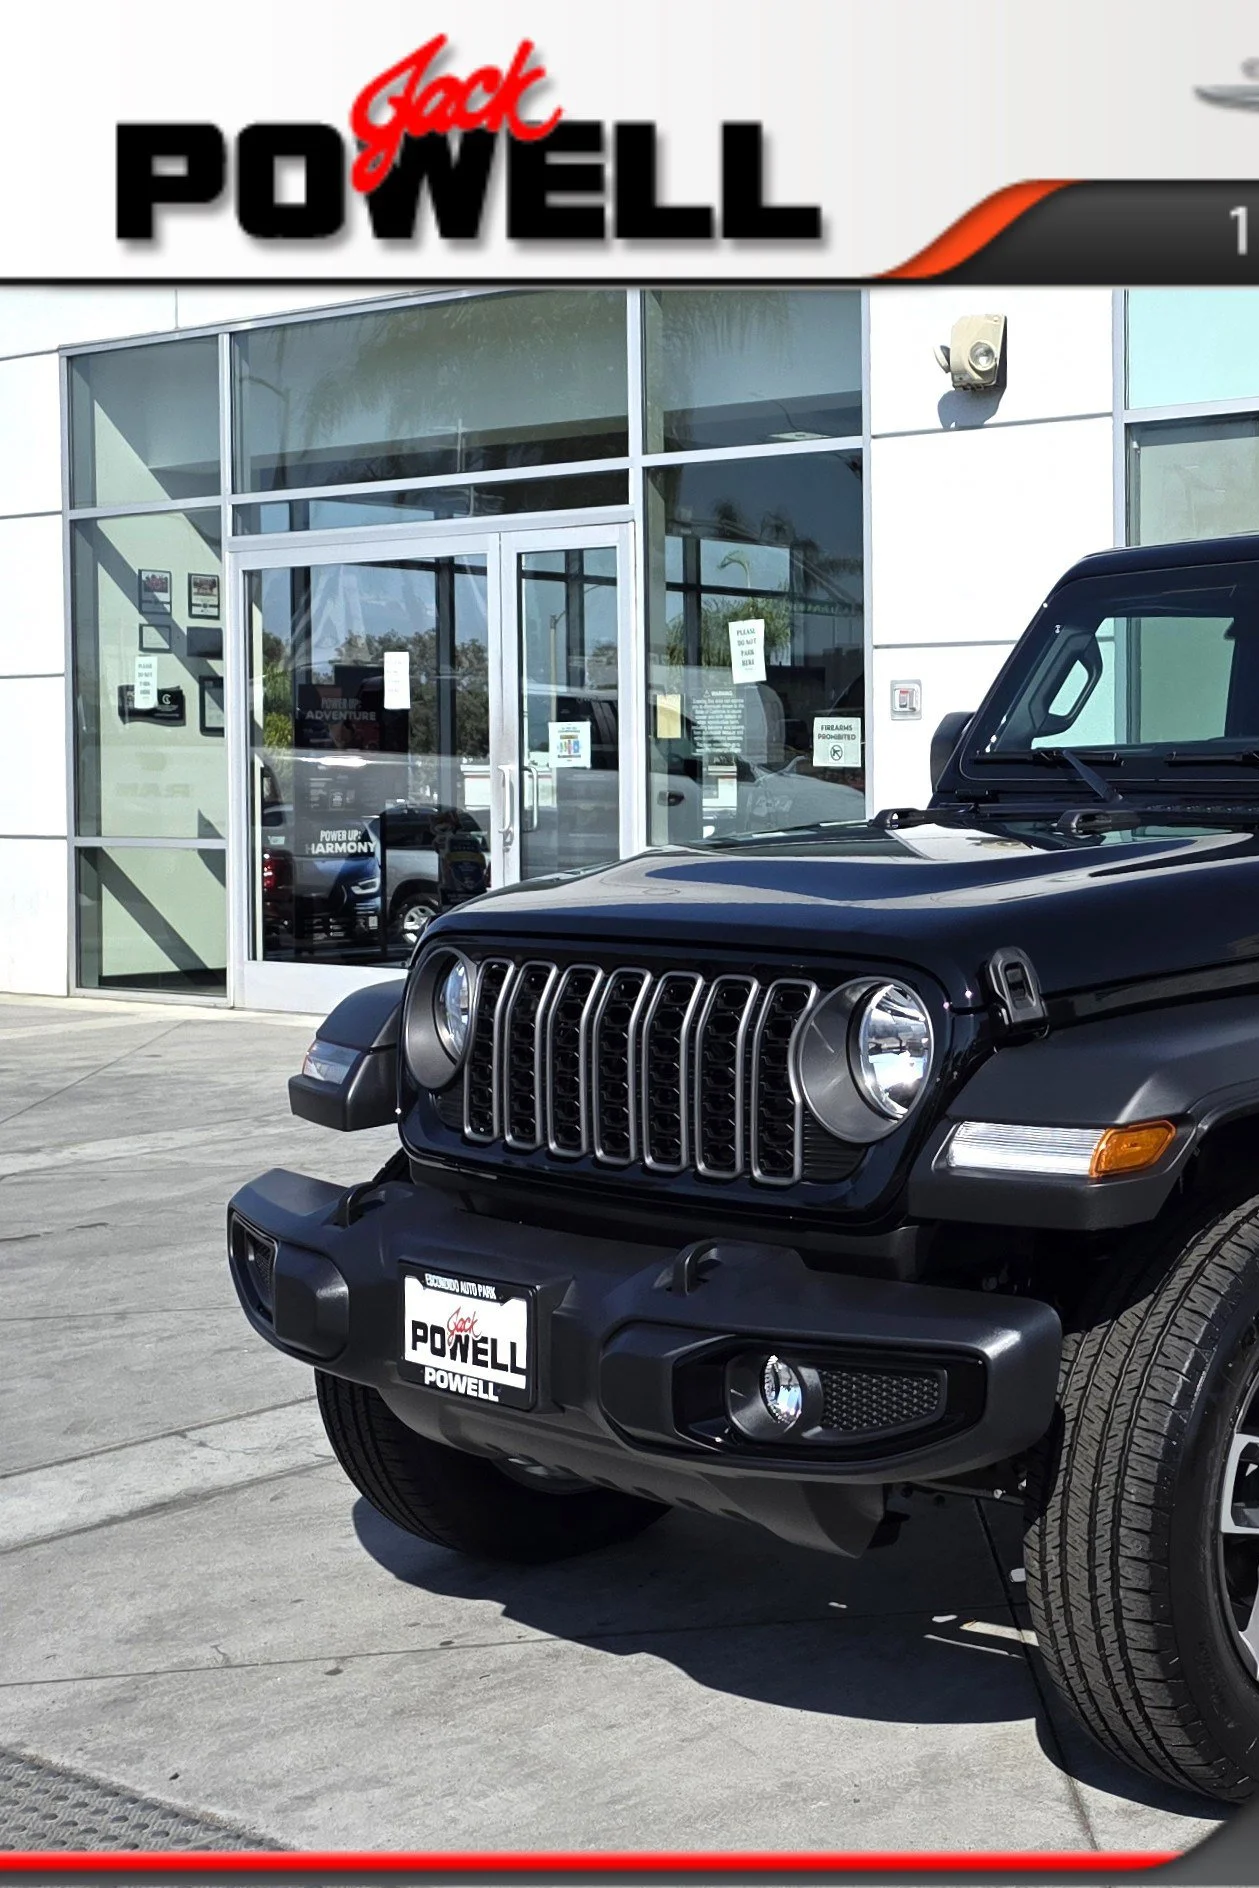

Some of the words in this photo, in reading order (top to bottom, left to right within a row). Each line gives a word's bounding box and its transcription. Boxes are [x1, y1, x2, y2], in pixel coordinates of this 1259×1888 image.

[321, 697, 347, 709] POWER
[305, 710, 377, 721] ADVENTURE
[817, 733, 856, 741] PROHIBITED
[320, 829, 347, 842] POWER
[305, 841, 377, 855] HARMONY
[460, 1280, 477, 1297] AUTO
[477, 1284, 497, 1300] PARK
[446, 1306, 482, 1347] Jack
[411, 1319, 527, 1376] POWELL
[424, 1366, 500, 1402] POWELL
